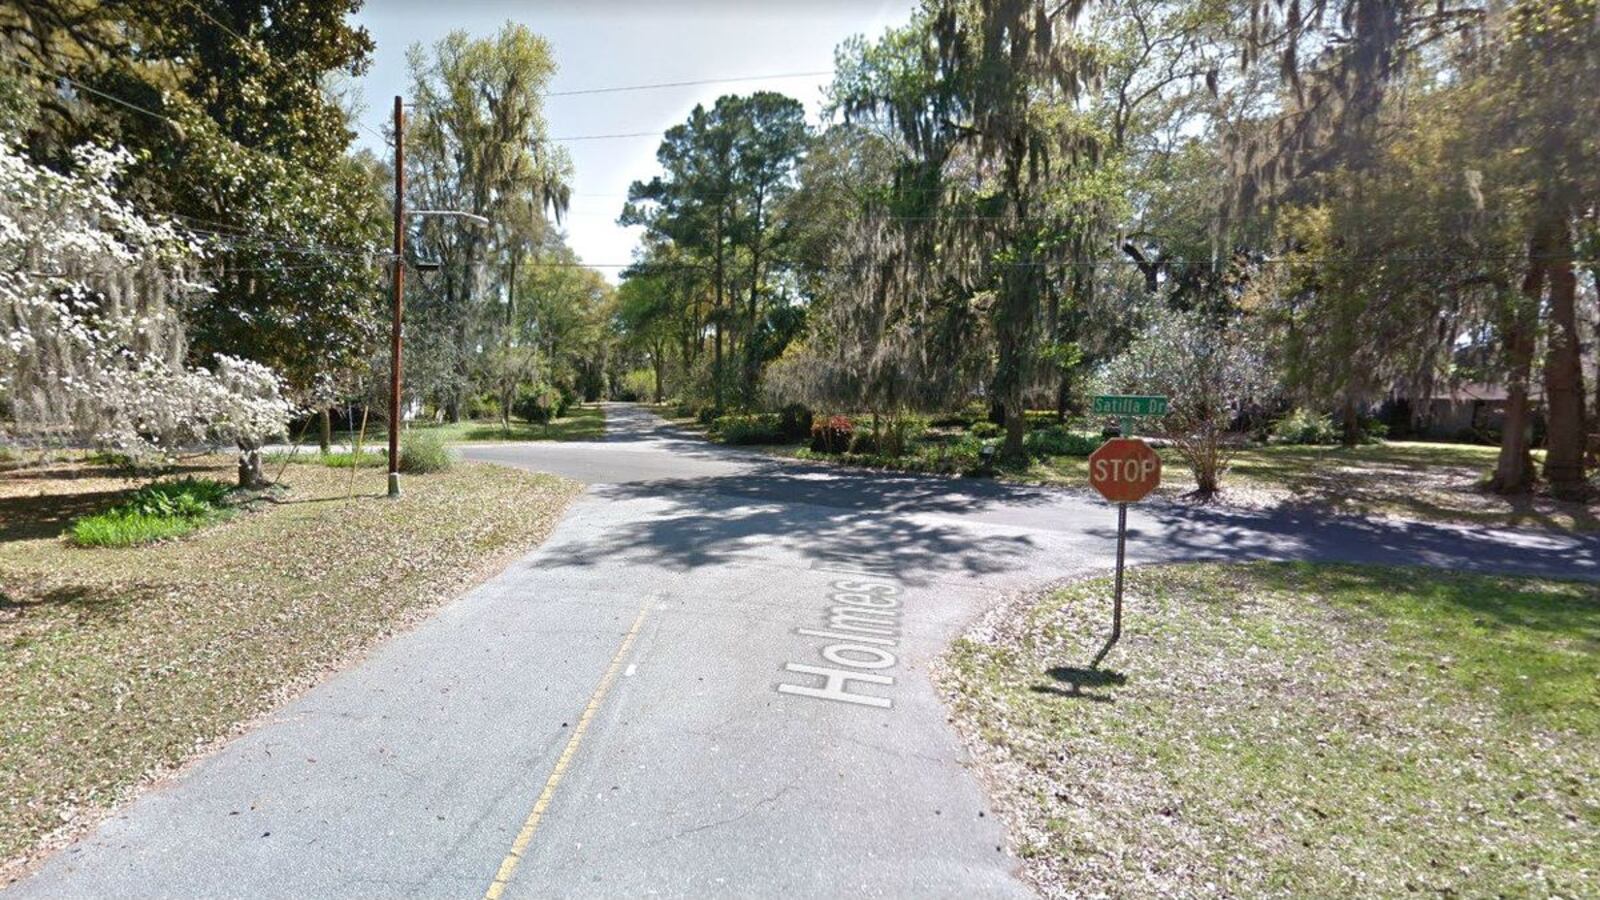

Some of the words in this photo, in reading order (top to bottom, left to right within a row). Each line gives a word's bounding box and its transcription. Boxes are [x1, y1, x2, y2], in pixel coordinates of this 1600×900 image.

[1095, 398, 1141, 413] Satilla
[1149, 399, 1165, 413] Dr
[1094, 459, 1154, 482] STOP
